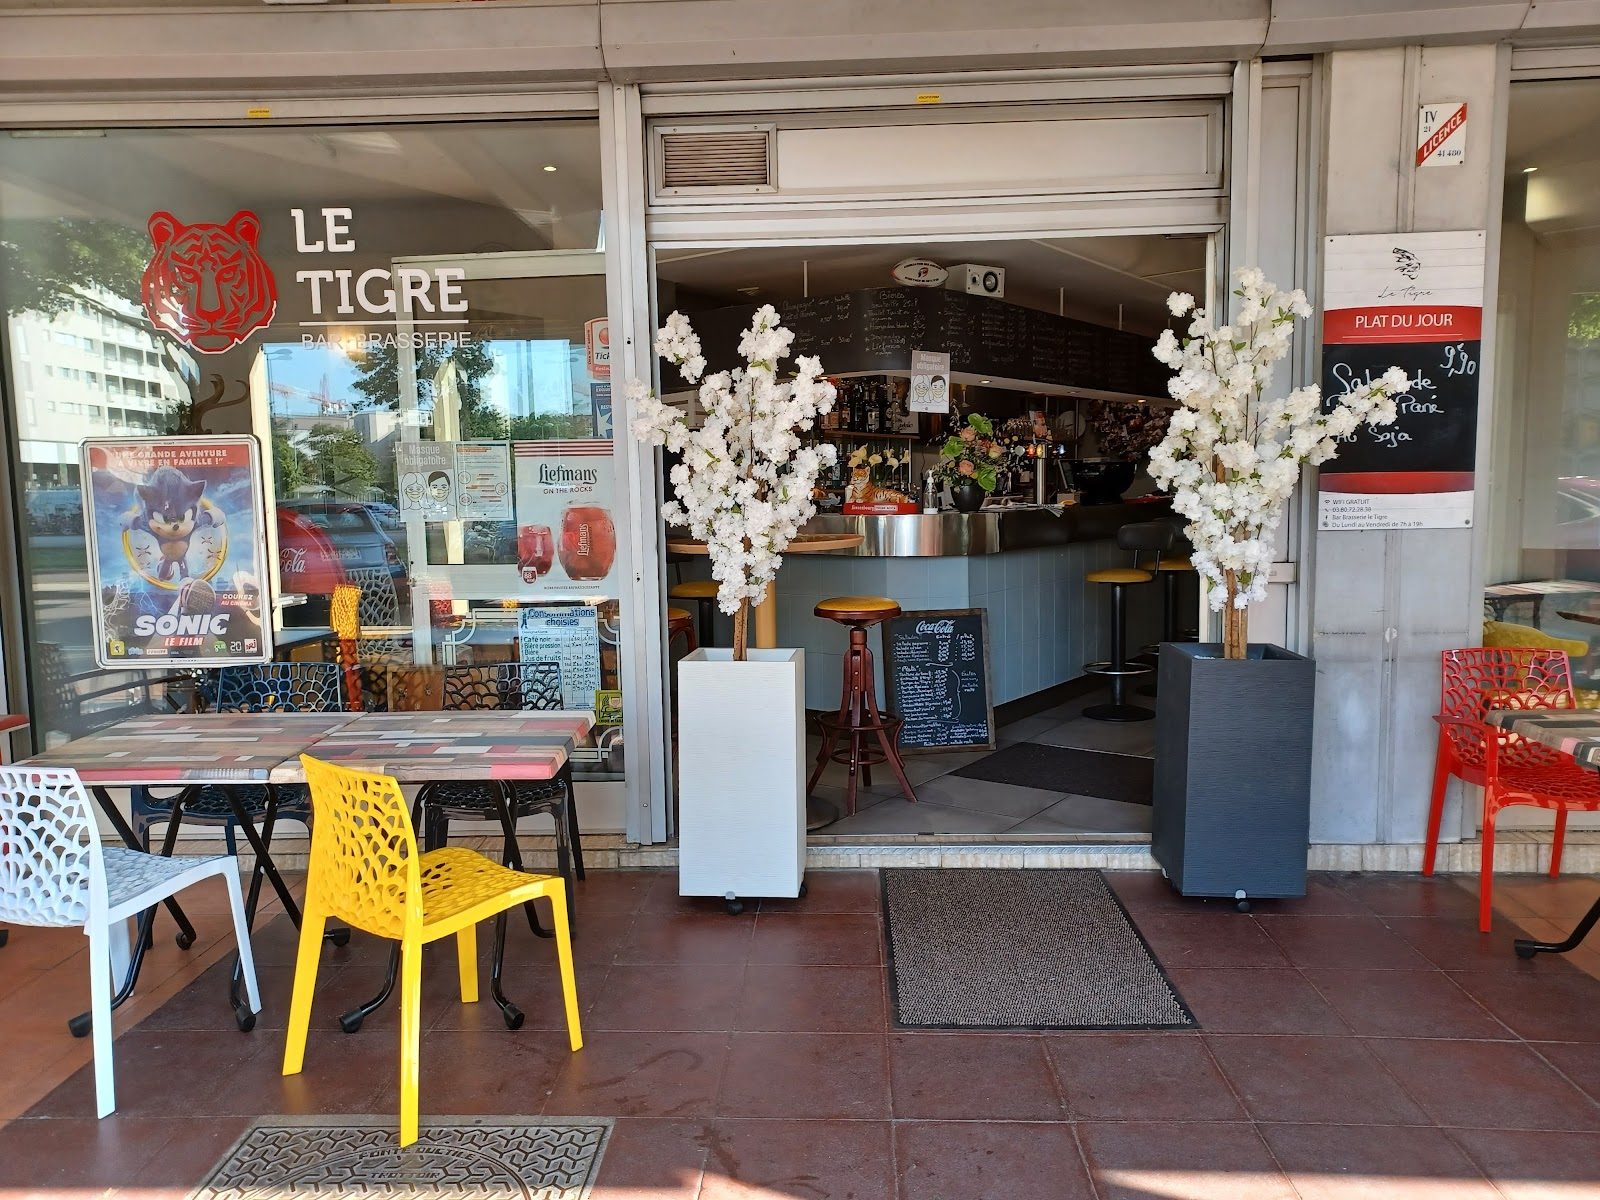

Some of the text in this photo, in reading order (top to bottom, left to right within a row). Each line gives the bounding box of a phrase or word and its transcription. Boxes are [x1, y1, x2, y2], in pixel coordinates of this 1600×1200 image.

[1425, 110, 1438, 123] IV
[1423, 110, 1463, 158] LICENCE
[291, 207, 356, 253] LE
[296, 267, 469, 315] TIGRE
[1378, 284, 1433, 301] Le Tigre
[1355, 313, 1453, 328] PLAT DU JOUR
[302, 331, 472, 351] BAR BRASSERIE
[1368, 426, 1413, 448] Soja
[138, 449, 176, 458] GRANDE
[179, 449, 227, 458] AVENTURE
[409, 444, 440, 456] Masque
[158, 458, 170, 467] EN
[174, 457, 212, 466] FAMILLE
[404, 455, 446, 467] obligatoire
[539, 463, 598, 485] Liefmans
[570, 486, 593, 494] ROCKS
[577, 523, 590, 556] Liefmans
[528, 608, 595, 619] Consommations
[133, 613, 231, 637] SONIC
[546, 617, 580, 626] choisies
[915, 620, 956, 634] Coca-Cola
[164, 637, 204, 646] LE FILM
[544, 654, 562, 662] fruits
[416, 1146, 476, 1160] DUCTILE
